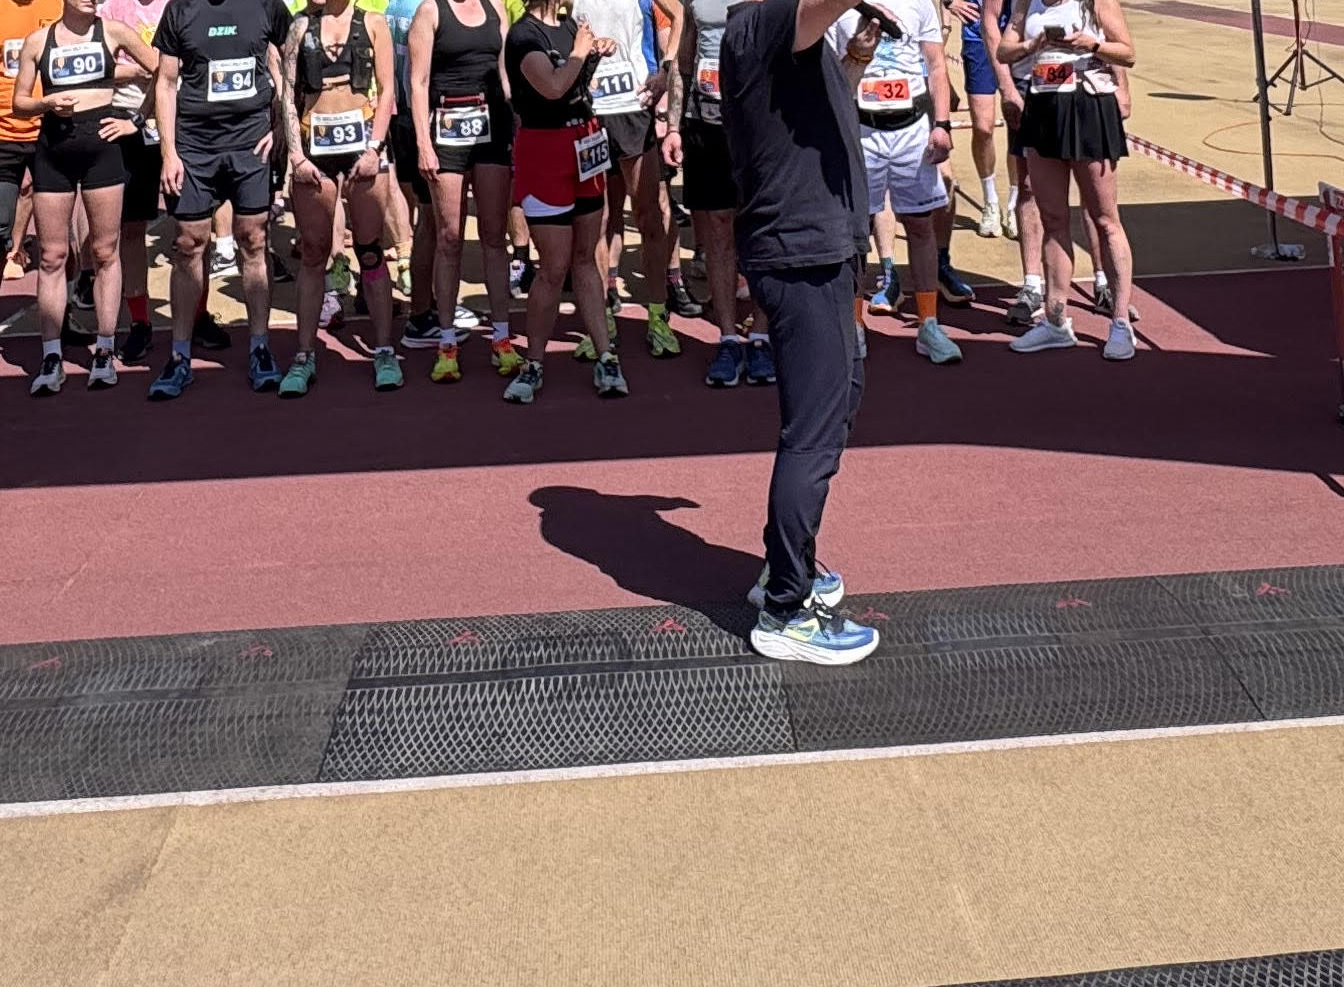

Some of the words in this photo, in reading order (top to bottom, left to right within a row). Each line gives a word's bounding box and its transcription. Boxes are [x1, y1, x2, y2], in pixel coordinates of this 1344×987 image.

[73, 55, 96, 74] 90
[232, 71, 252, 90] 94
[600, 73, 632, 94] 111
[883, 82, 905, 99] 32
[332, 124, 357, 144] 93
[460, 118, 483, 136] 88
[589, 143, 608, 165] 115
